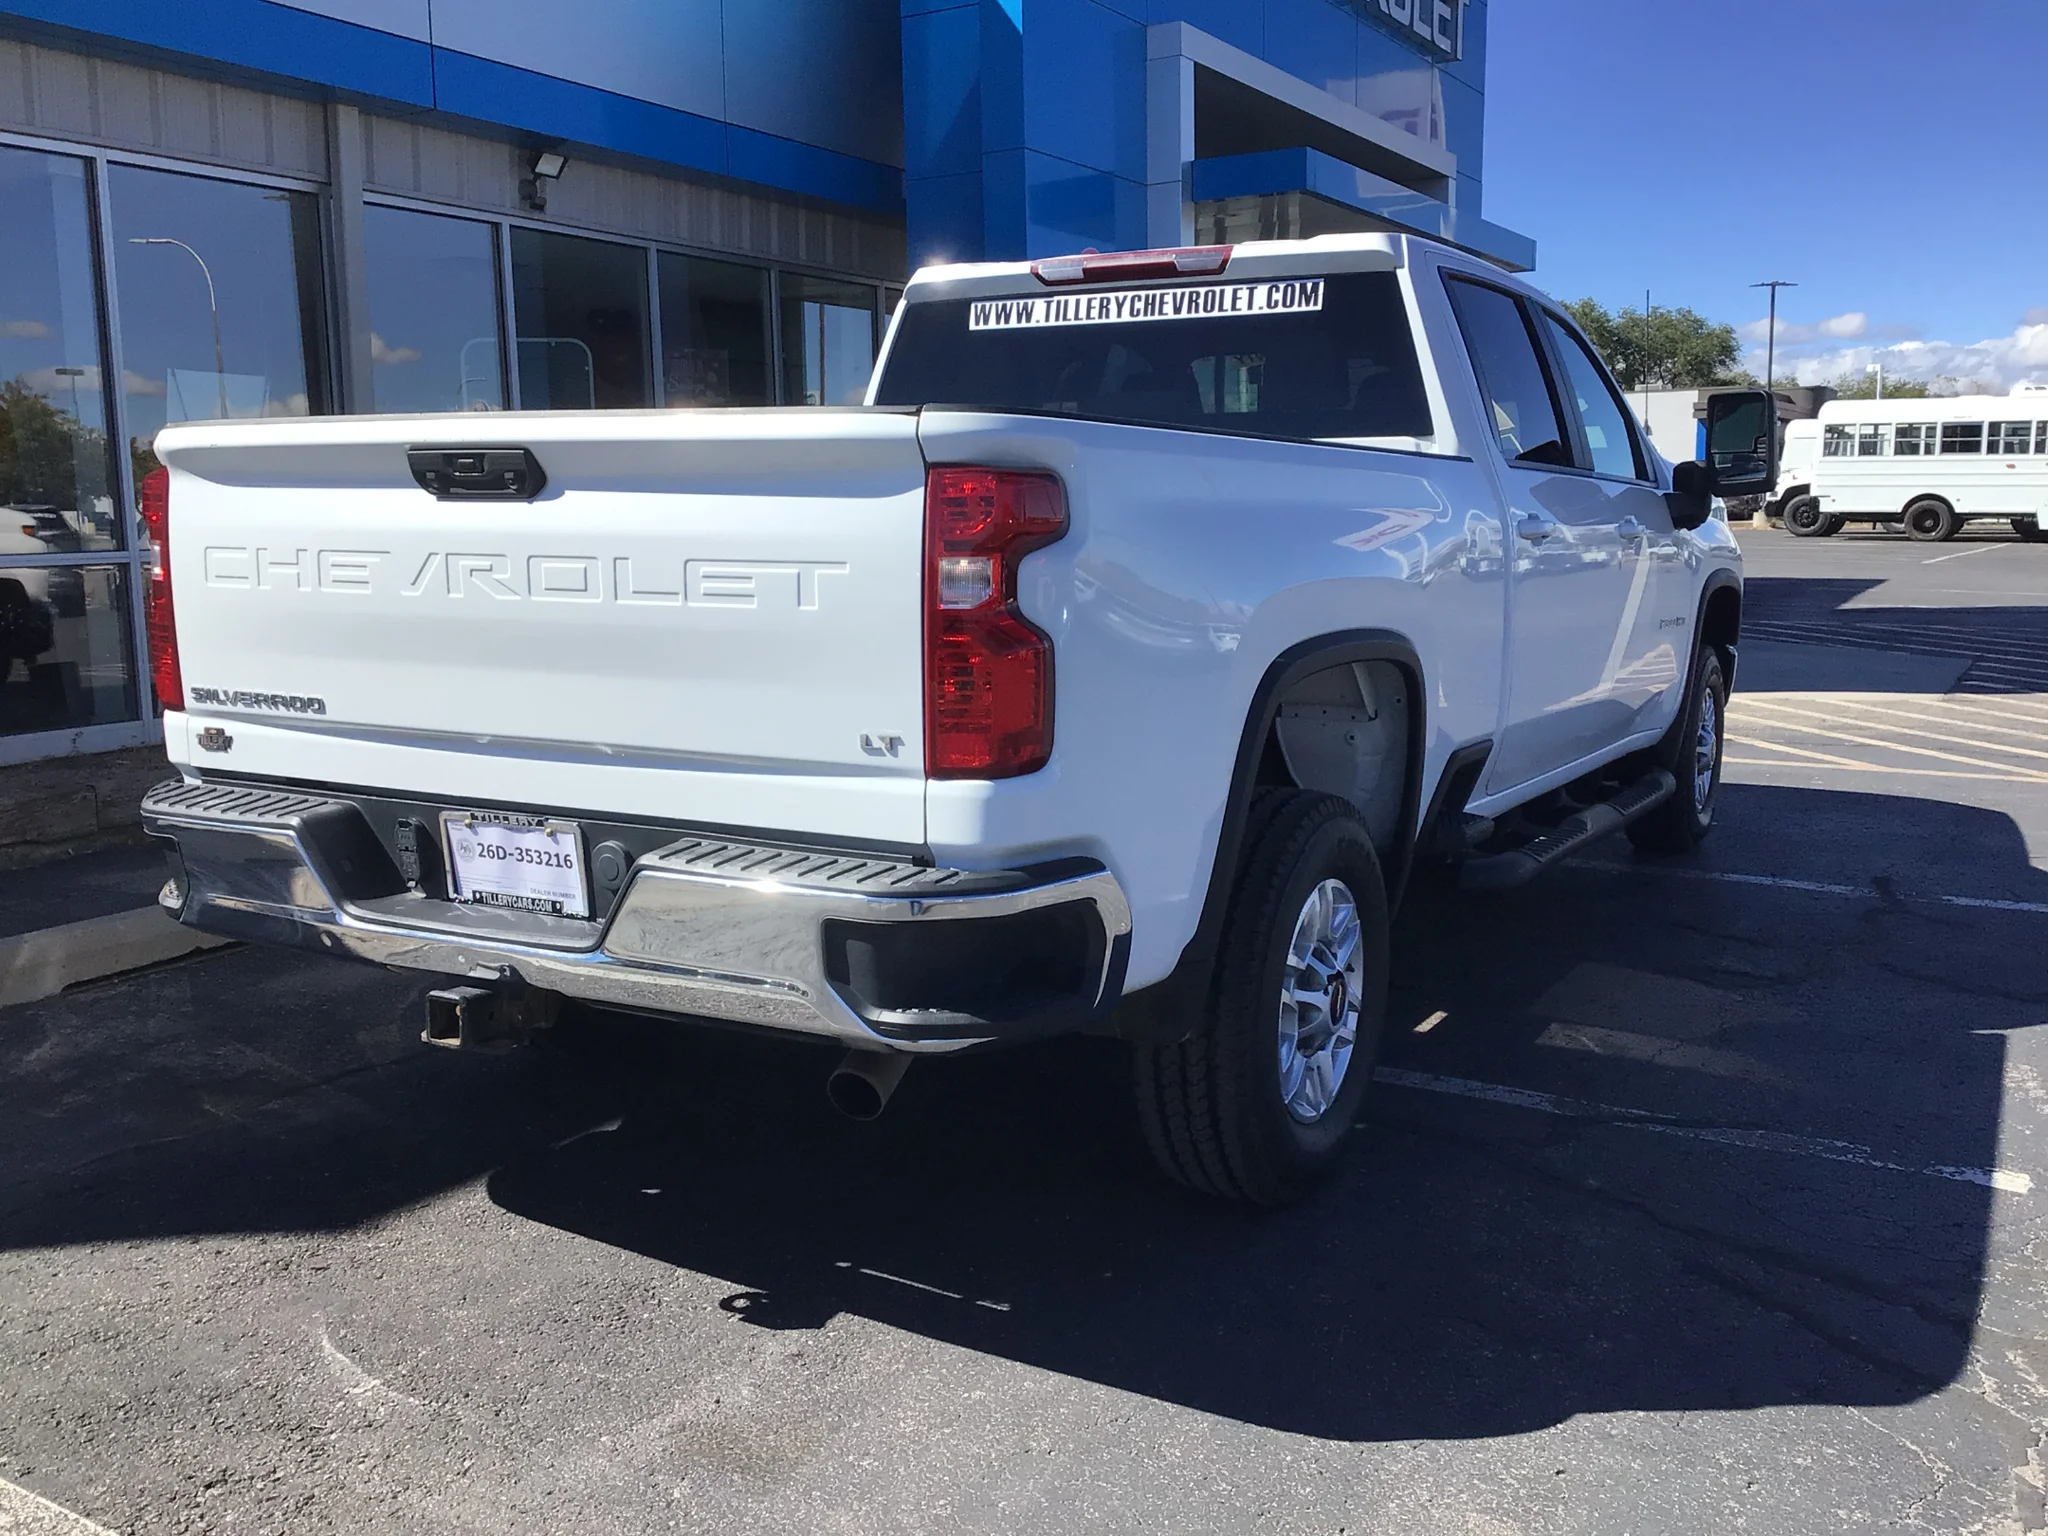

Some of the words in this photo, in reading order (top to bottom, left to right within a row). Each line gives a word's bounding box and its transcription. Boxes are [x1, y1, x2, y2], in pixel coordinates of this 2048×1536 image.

[1367, 0, 1470, 60] LET
[974, 284, 1320, 327] WWW.TILLERYCHEVROLET.COM
[204, 546, 849, 610] CHEVROLET
[190, 686, 327, 715] SILVERADO
[859, 733, 905, 758] LT
[474, 811, 538, 827] TILLERY
[476, 842, 574, 870] 26D-353216
[481, 892, 553, 912] TILLERYCARS.COM
[530, 887, 551, 896] DEALER
[552, 890, 576, 899] NUMBER
